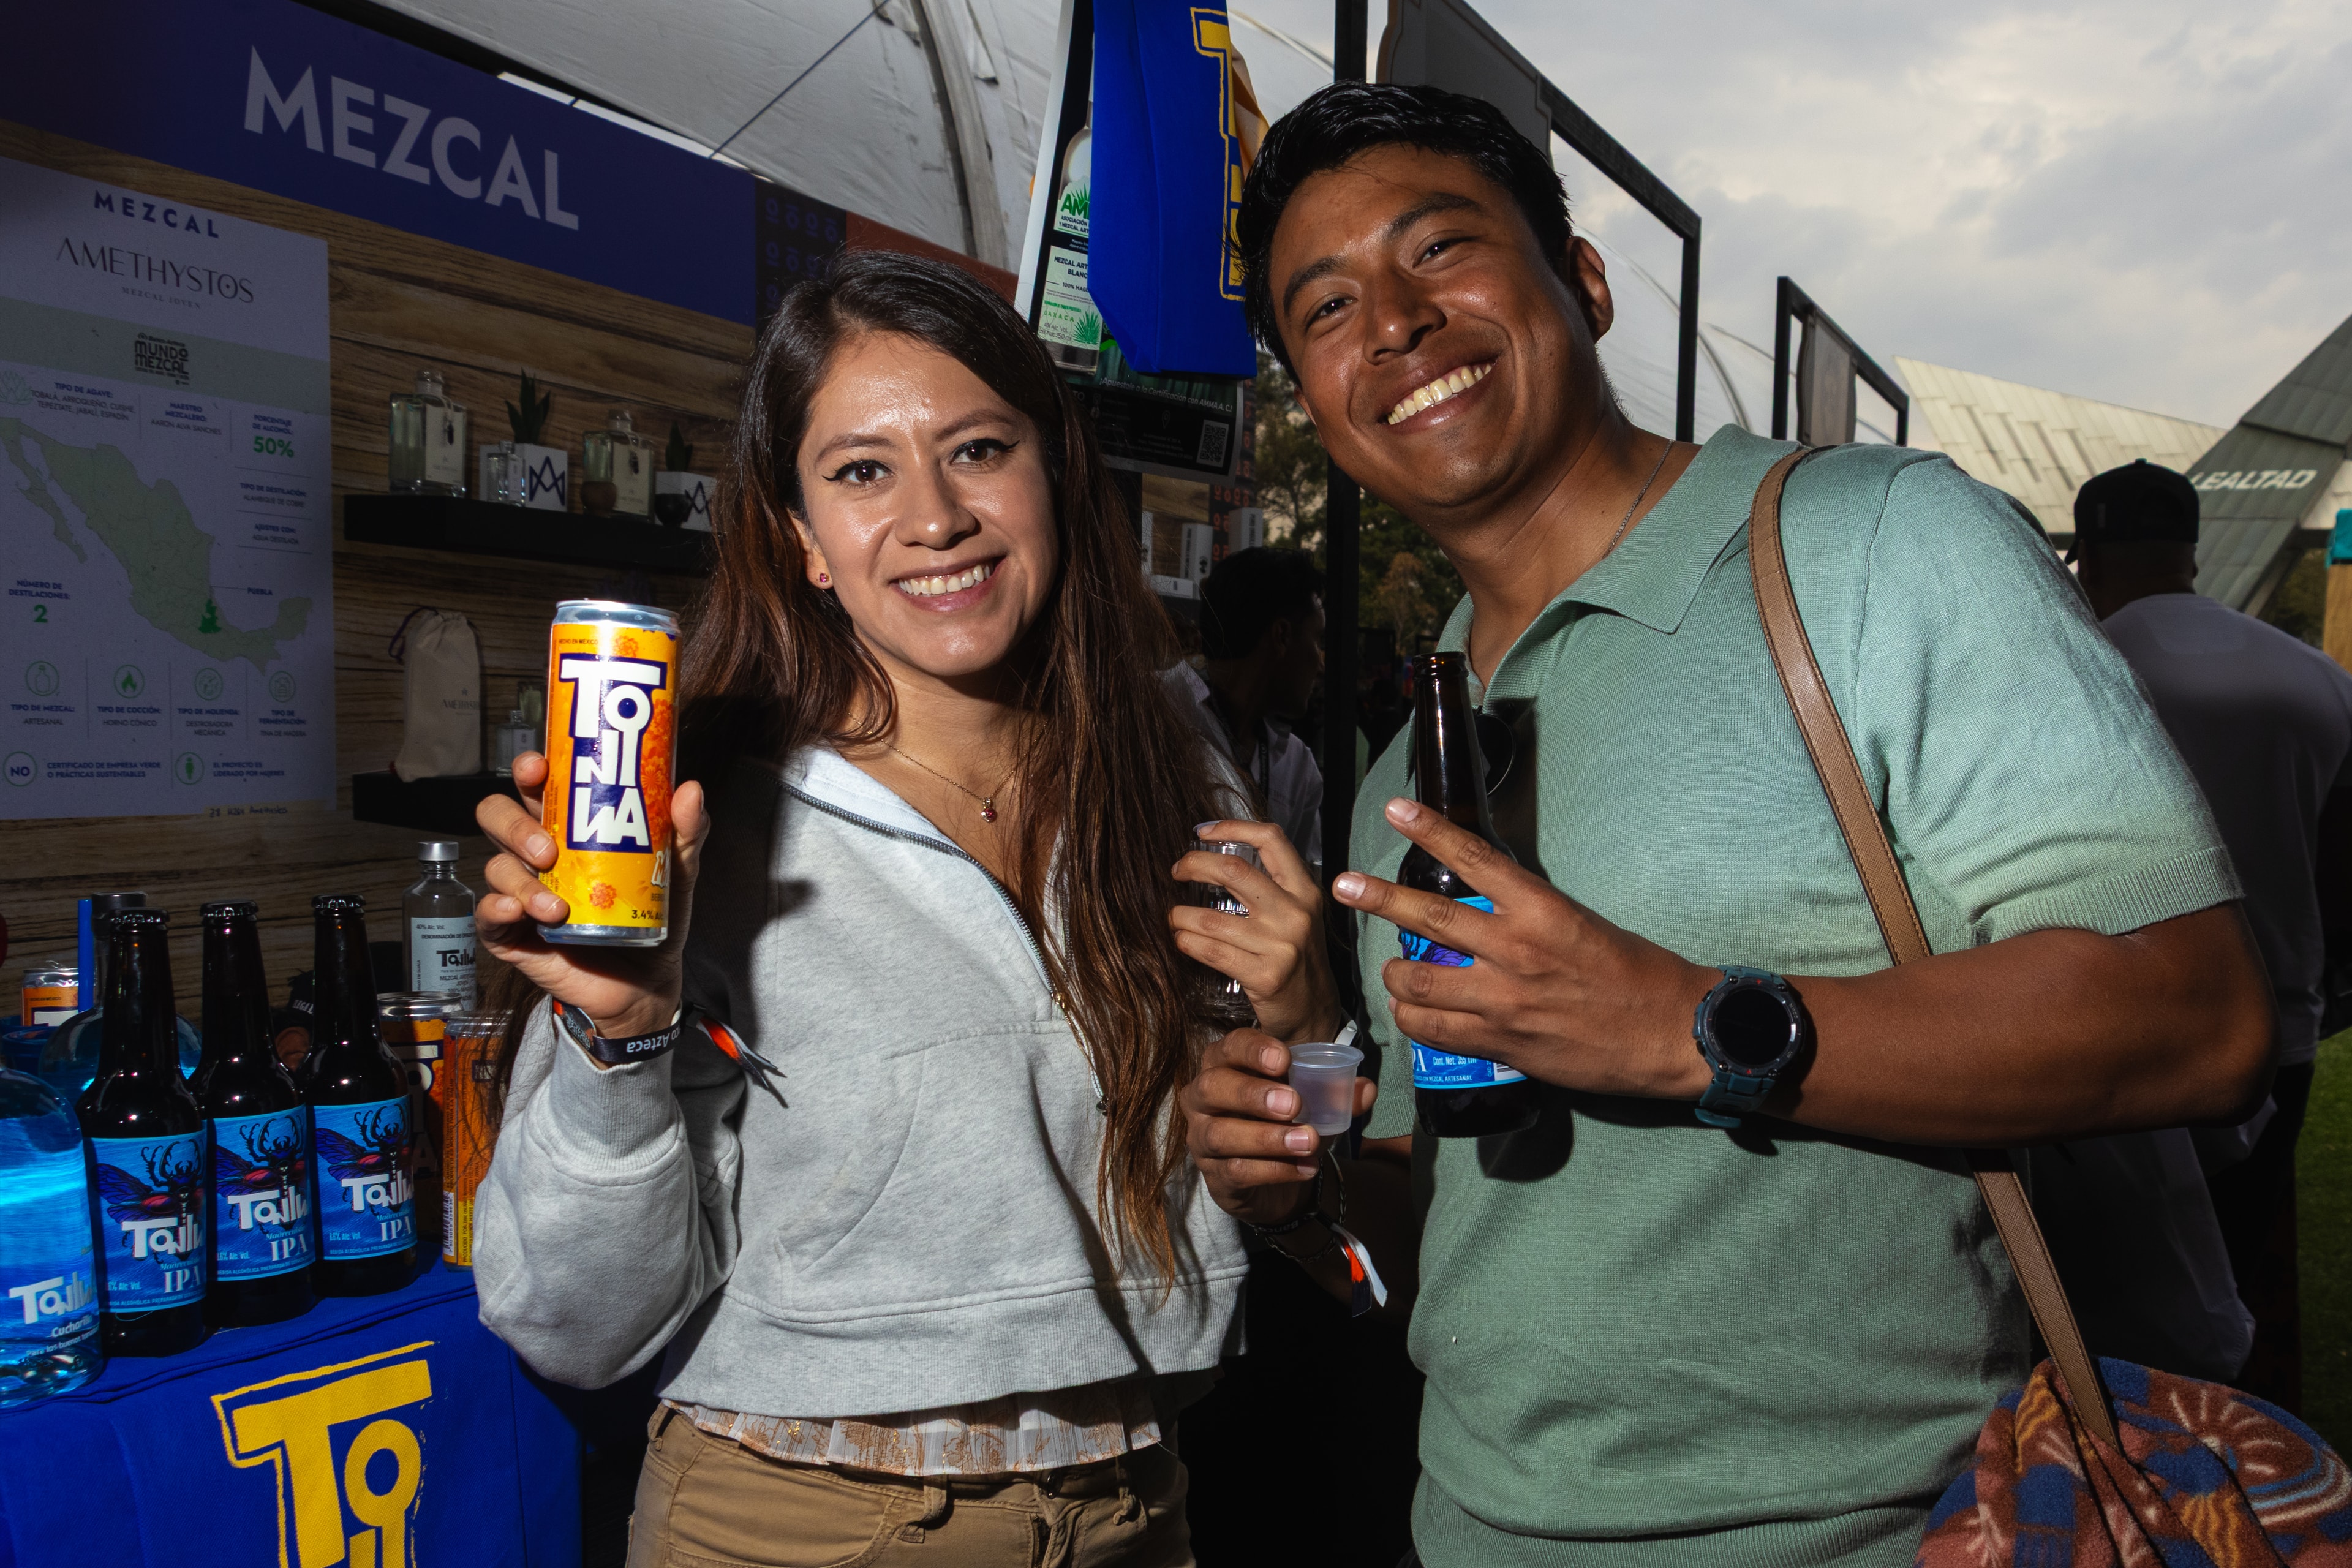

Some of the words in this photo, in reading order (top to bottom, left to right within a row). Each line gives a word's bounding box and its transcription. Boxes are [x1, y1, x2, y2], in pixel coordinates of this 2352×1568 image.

[244, 45, 579, 231] MEZCAL
[94, 190, 219, 239] MEZCAL
[1060, 193, 1090, 219] AM
[1062, 222, 1079, 231] MEZCAL
[1054, 256, 1075, 266] MEZCAL
[56, 237, 254, 304] AMETHYSTOS
[1068, 269, 1088, 279] BLANC
[122, 287, 165, 303] MEZCAL
[169, 296, 201, 309] JOVEN
[1044, 310, 1074, 322] OAXACA
[135, 340, 189, 361] MUNDO
[135, 353, 189, 375] MEZCAL
[55, 382, 72, 391] TIPO
[86, 388, 113, 398] AGAVE:
[1148, 386, 1186, 402] Certificación
[1199, 399, 1218, 409] AMMA
[165, 410, 206, 423] MEZCALERO:
[170, 402, 202, 413] MAESTRO
[254, 414, 292, 428] PORCENTAJE
[253, 435, 294, 458] 50%
[17, 579, 50, 589] NÚMERO
[9, 589, 70, 600] DESTILACIONES:
[34, 604, 48, 623] 2
[10, 766, 30, 777] NO
[632, 910, 654, 919] 3.4%
[627, 1033, 671, 1054] Azteca
[1446, 1056, 1456, 1065] Net.
[380, 1216, 412, 1242] IPA
[271, 1234, 308, 1261] IPA
[164, 1265, 201, 1294] IPA
[46, 1344, 57, 1353] los
[58, 1336, 81, 1349] buenos
